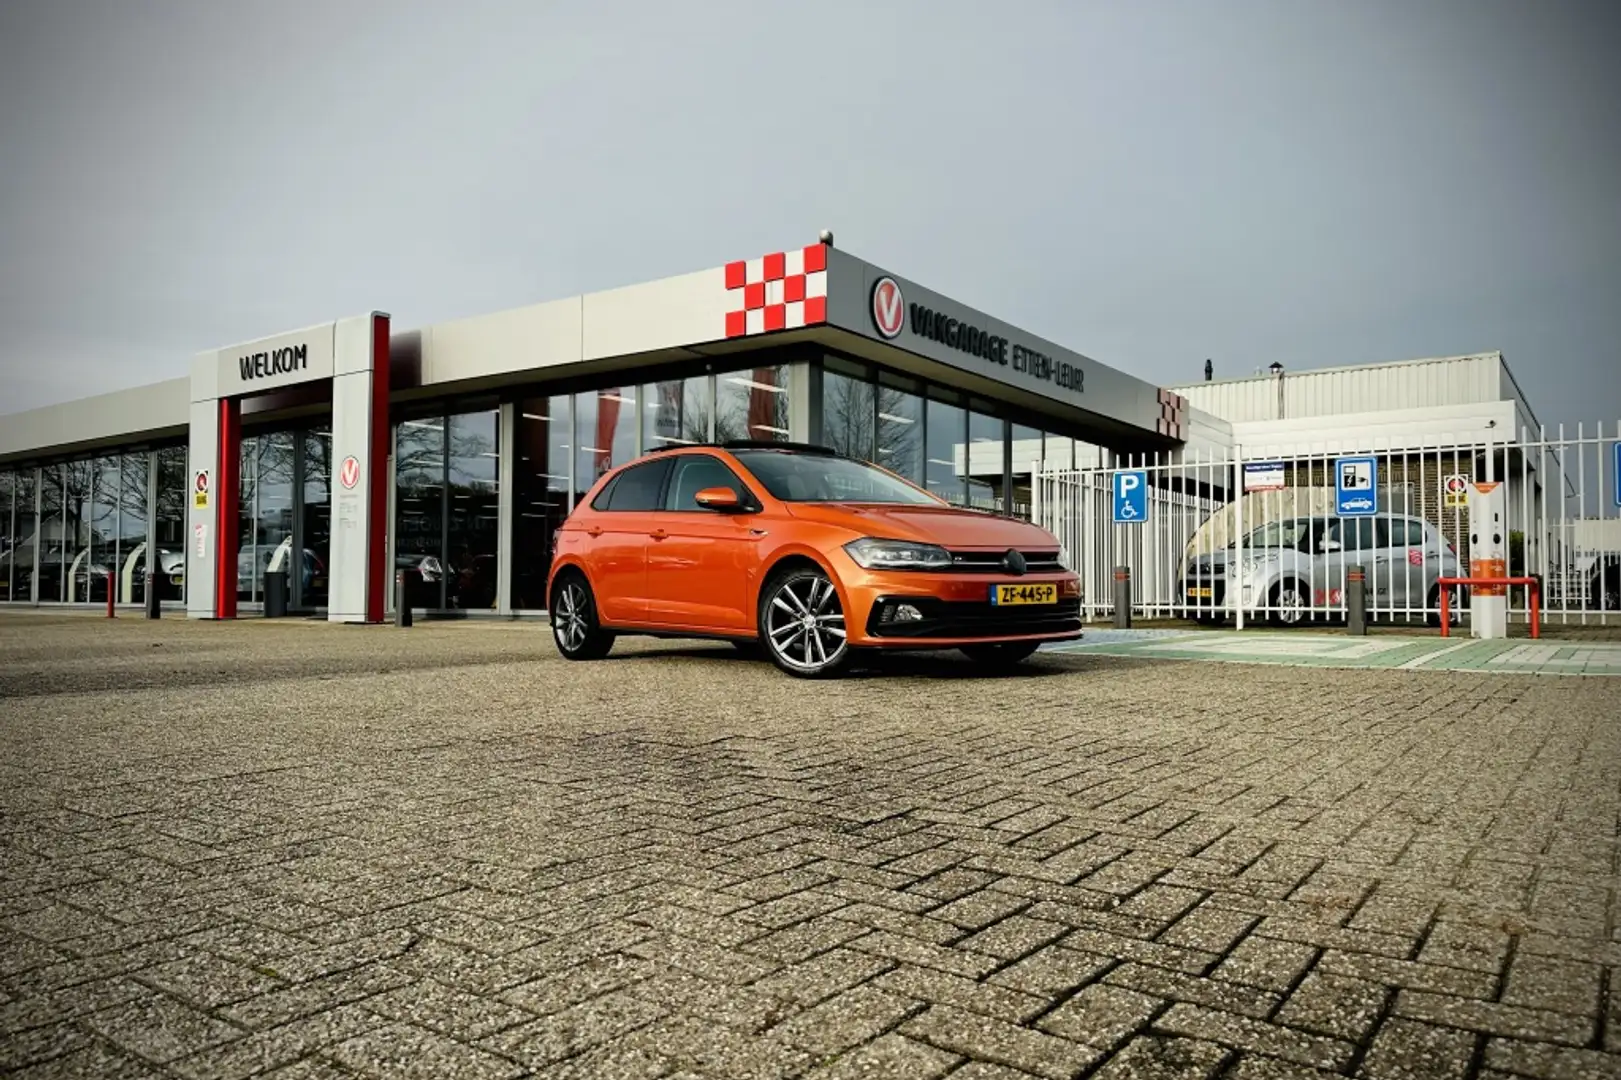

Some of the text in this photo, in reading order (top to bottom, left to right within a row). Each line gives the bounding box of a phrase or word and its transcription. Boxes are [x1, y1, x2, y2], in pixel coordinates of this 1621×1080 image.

[880, 286, 899, 330] V
[239, 343, 307, 381] WELKOM
[1121, 475, 1138, 498] P
[1002, 586, 1053, 603] ZF-445-P
